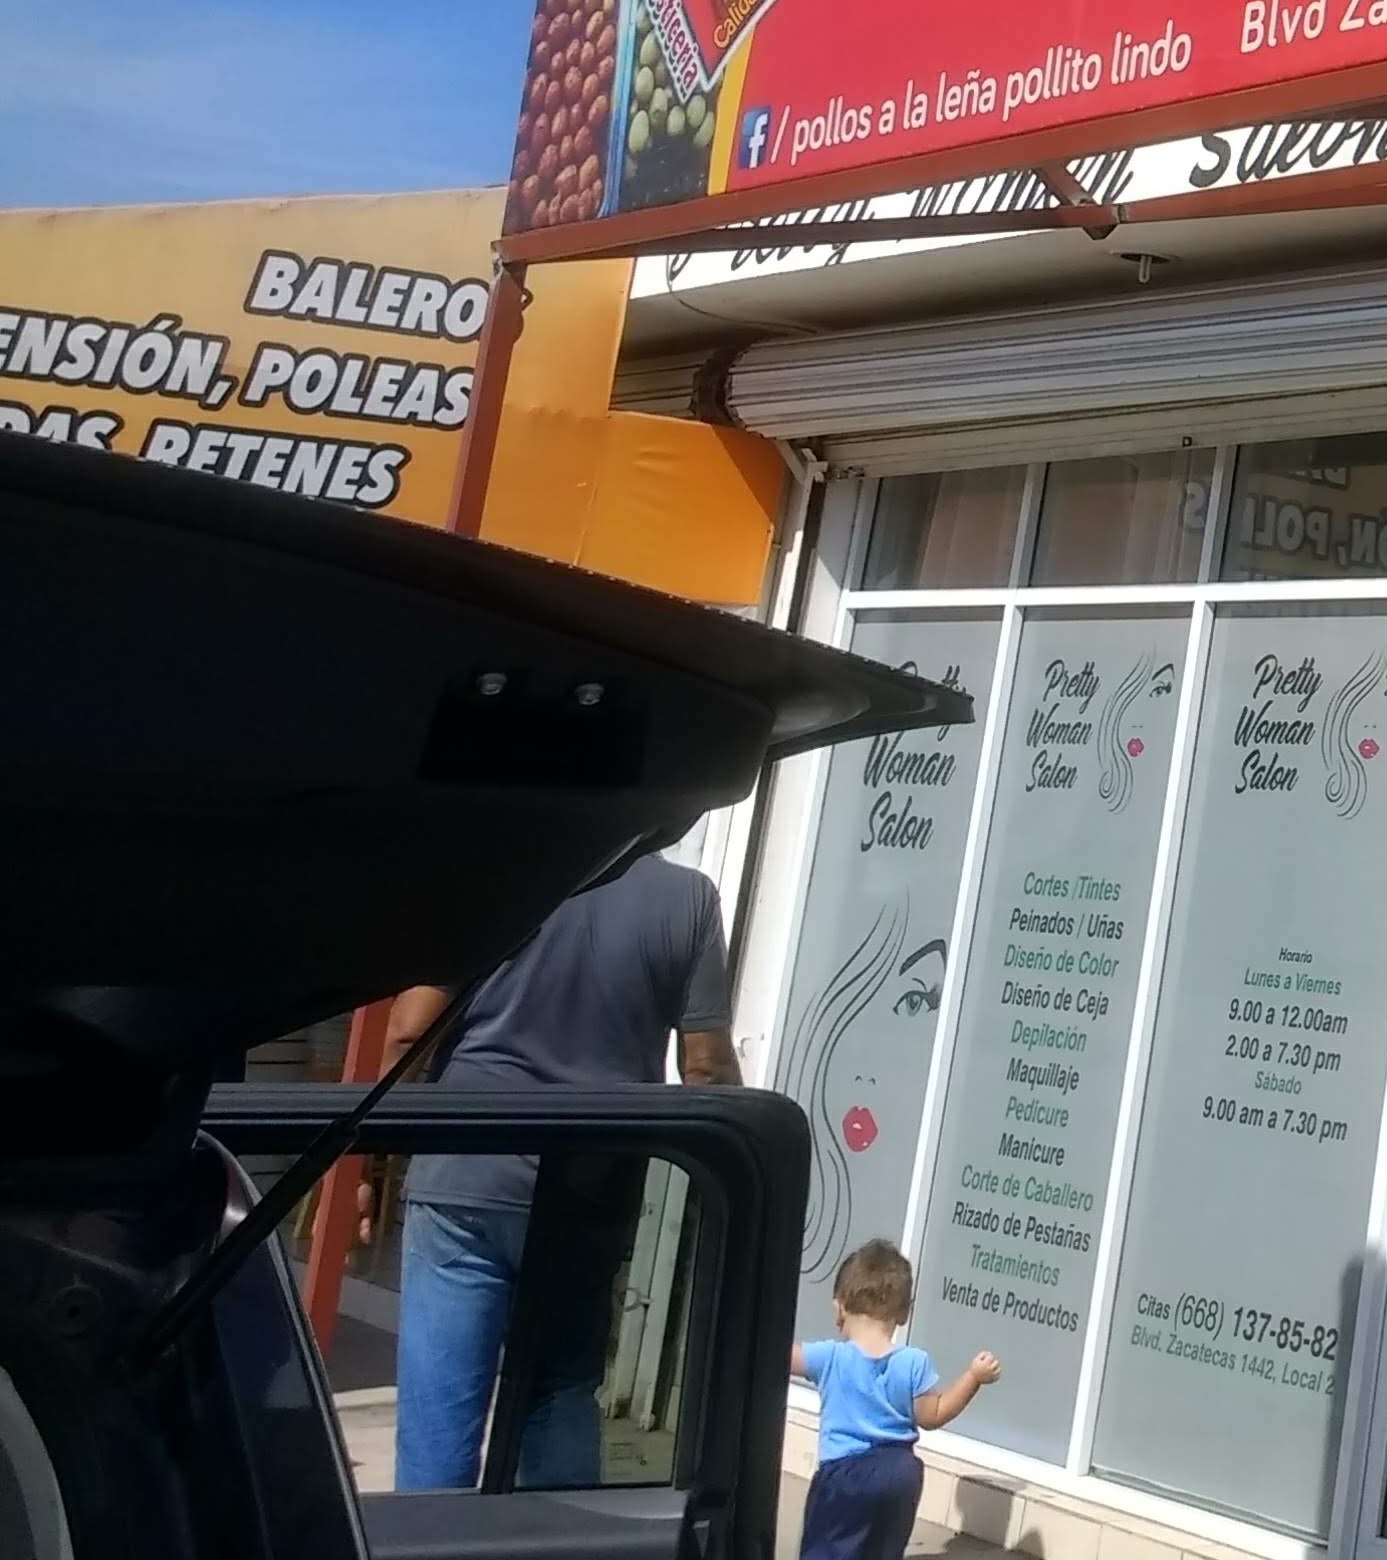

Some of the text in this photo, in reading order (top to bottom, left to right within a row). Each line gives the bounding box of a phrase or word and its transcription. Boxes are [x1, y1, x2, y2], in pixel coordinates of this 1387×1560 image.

[790, 95, 873, 167] pollos
[878, 100, 896, 134] a
[903, 79, 928, 129] la
[935, 69, 997, 122] leña
[1002, 45, 1102, 123] pollito
[1110, 19, 1192, 85] lindo
[243, 345, 475, 427] POLEAS
[145, 423, 406, 505] RETENES
[1042, 659, 1100, 715] Pretty
[1252, 654, 1323, 713] Pretty
[1025, 702, 1093, 748] Woman
[1234, 699, 1316, 748] Woman
[863, 731, 957, 788] Woman
[1025, 749, 1079, 792] Salon
[1234, 748, 1299, 794] Salon
[860, 790, 934, 852] Salon
[1023, 871, 1070, 898] Cortes
[1008, 907, 1075, 936] Peinados
[1086, 913, 1124, 940] Uñas
[1003, 943, 1120, 978] Diseño de Color
[1278, 947, 1313, 965] Horario
[1001, 980, 1110, 1021] Diseño de Ceja
[1243, 966, 1342, 996] Lunes a Viernes
[1010, 1019, 1088, 1052] Depilación
[1228, 997, 1349, 1035] 9.00 a 12.00am
[1006, 1057, 1080, 1096] Maquillaje
[1224, 1033, 1342, 1075] 2.00 a 7.30 pm
[1005, 1095, 1069, 1128] Pedicure
[1202, 1095, 1348, 1144] 9.00 am a 7.30 pm
[998, 1132, 1065, 1167] Manicure
[961, 1164, 1094, 1212] Corte de Caballero
[951, 1200, 1092, 1253] Rizado de Pestañas
[970, 1243, 1061, 1287] Tratamientos
[941, 1276, 1079, 1333] Venta de Productos
[1137, 1292, 1339, 1361] Citas (668) 137-85-82
[1130, 1324, 1162, 1352] Blvd.
[1165, 1333, 1236, 1371] Zacatecas
[1240, 1353, 1276, 1384] 1442,
[1281, 1362, 1324, 1393] Local
